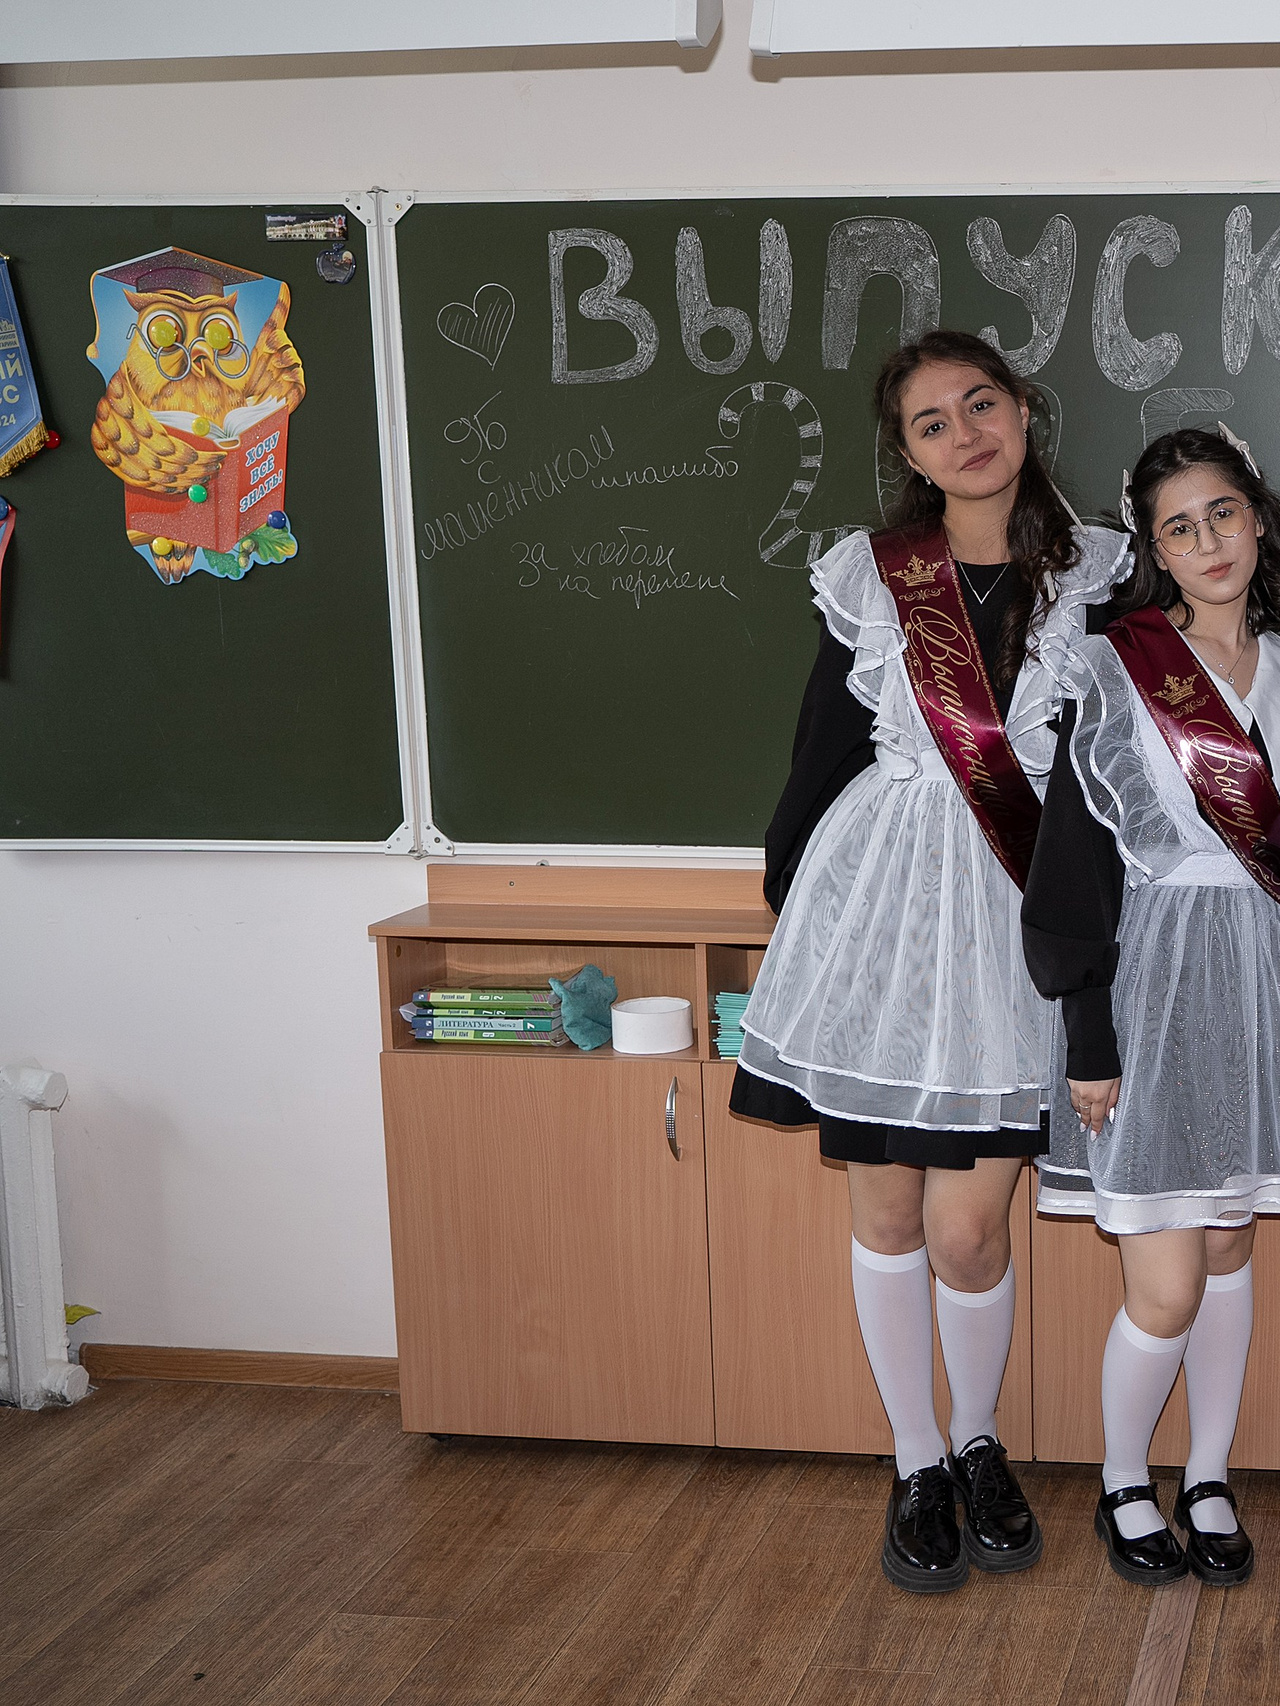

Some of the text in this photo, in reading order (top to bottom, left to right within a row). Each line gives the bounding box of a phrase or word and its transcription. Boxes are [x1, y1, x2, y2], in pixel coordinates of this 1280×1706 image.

[0, 413, 16, 427] 24
[245, 431, 280, 467] ХОЧУ
[250, 454, 275, 485] ВСЁ
[239, 469, 283, 513] ЗНАТЬ!
[438, 1020, 494, 1028] ЛИТЕРАТУРА
